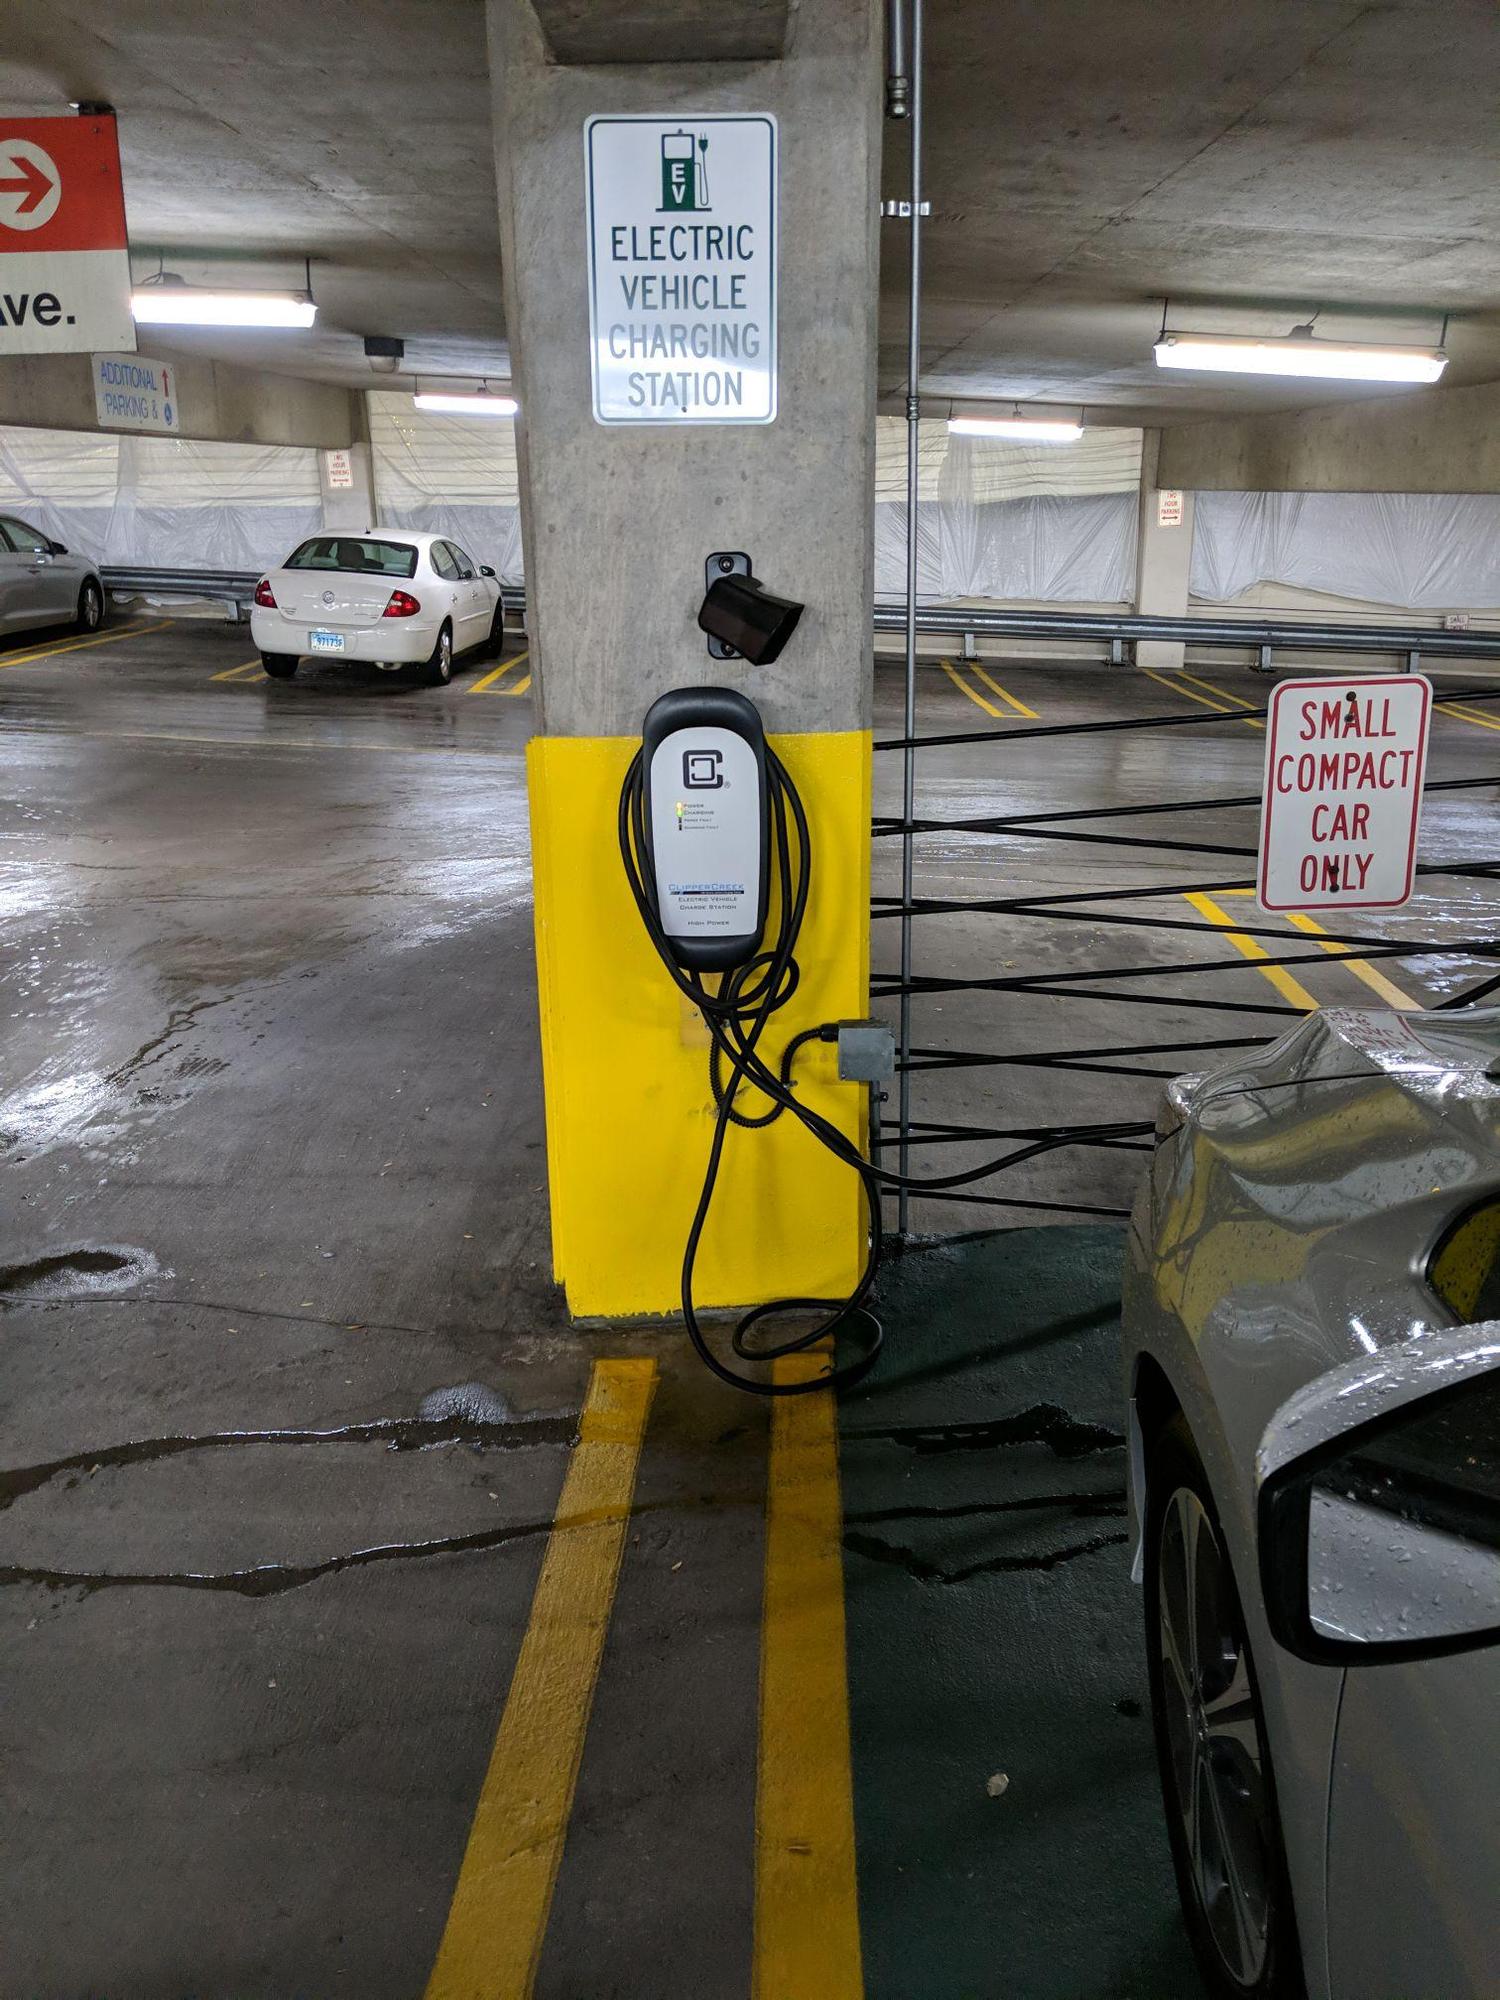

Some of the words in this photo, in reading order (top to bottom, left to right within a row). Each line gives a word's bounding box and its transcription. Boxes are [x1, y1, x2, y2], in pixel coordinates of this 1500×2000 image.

[671, 163, 686, 204] EV
[611, 224, 754, 262] ELECTRIC
[620, 274, 747, 310] VEHICLE
[608, 322, 760, 359] CHARGING
[101, 361, 157, 391] ADDITIONAL
[628, 371, 742, 407] STATION
[104, 393, 148, 419] PARKING
[1300, 699, 1396, 740] SMALL
[1277, 751, 1414, 793] COMPACT
[1312, 804, 1370, 842] CAR
[1300, 854, 1374, 893] ONLY
